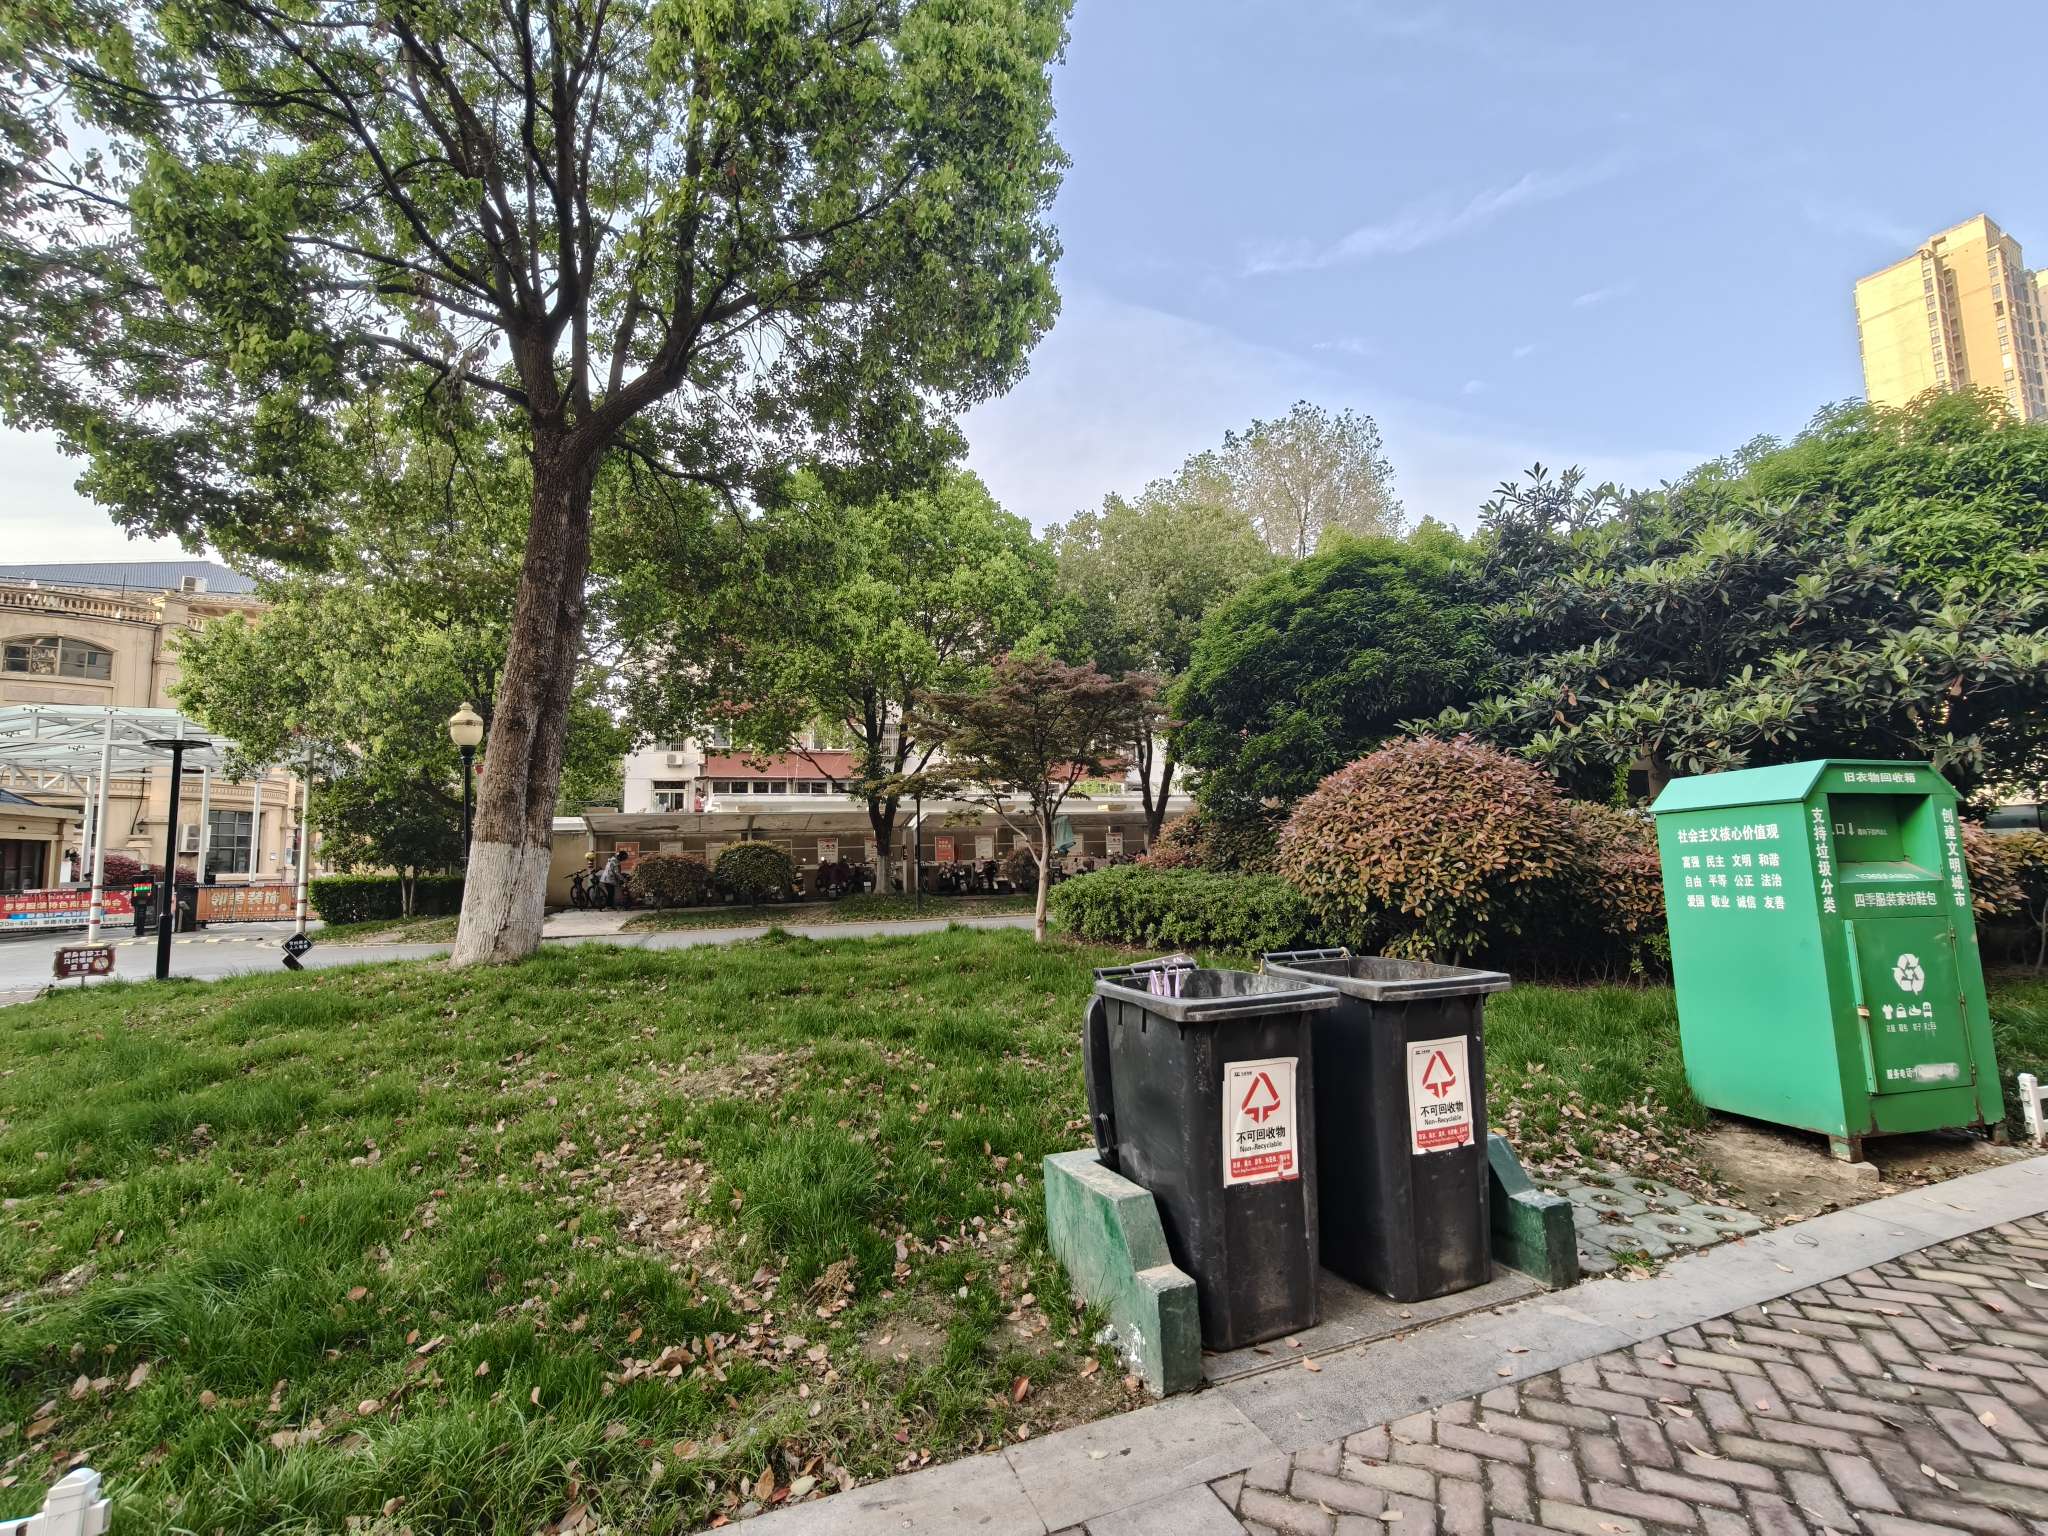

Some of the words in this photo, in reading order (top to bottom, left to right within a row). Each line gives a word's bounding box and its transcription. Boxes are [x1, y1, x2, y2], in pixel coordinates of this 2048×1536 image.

[1844, 772, 1916, 783] 旧衣物回收箱
[1677, 823, 1780, 843] 社会主义核心价值观
[1682, 855, 1701, 868] 富强
[1706, 854, 1726, 868] 民主
[1732, 853, 1752, 867] 文明
[1758, 852, 1780, 867] 和谐
[1811, 807, 1837, 913] 支持垃圾分类
[1941, 808, 1966, 907] 创建文明城市
[1685, 875, 1703, 888] 自由
[1708, 874, 1728, 888] 平等
[1734, 874, 1755, 887] 公正
[1761, 873, 1783, 887] 法治
[1687, 894, 1705, 908] 爱国
[1711, 895, 1731, 908] 敬业
[1736, 896, 1757, 909] 诚信
[1764, 896, 1785, 909] 友善
[1854, 892, 1938, 907] 四季服装家纺鞋包
[1421, 1100, 1464, 1118] 不可回收物
[1424, 1115, 1462, 1126] Non-Recyclable
[1236, 1125, 1286, 1144] 不可回收物
[1239, 1141, 1283, 1153] Non-Recyclable
